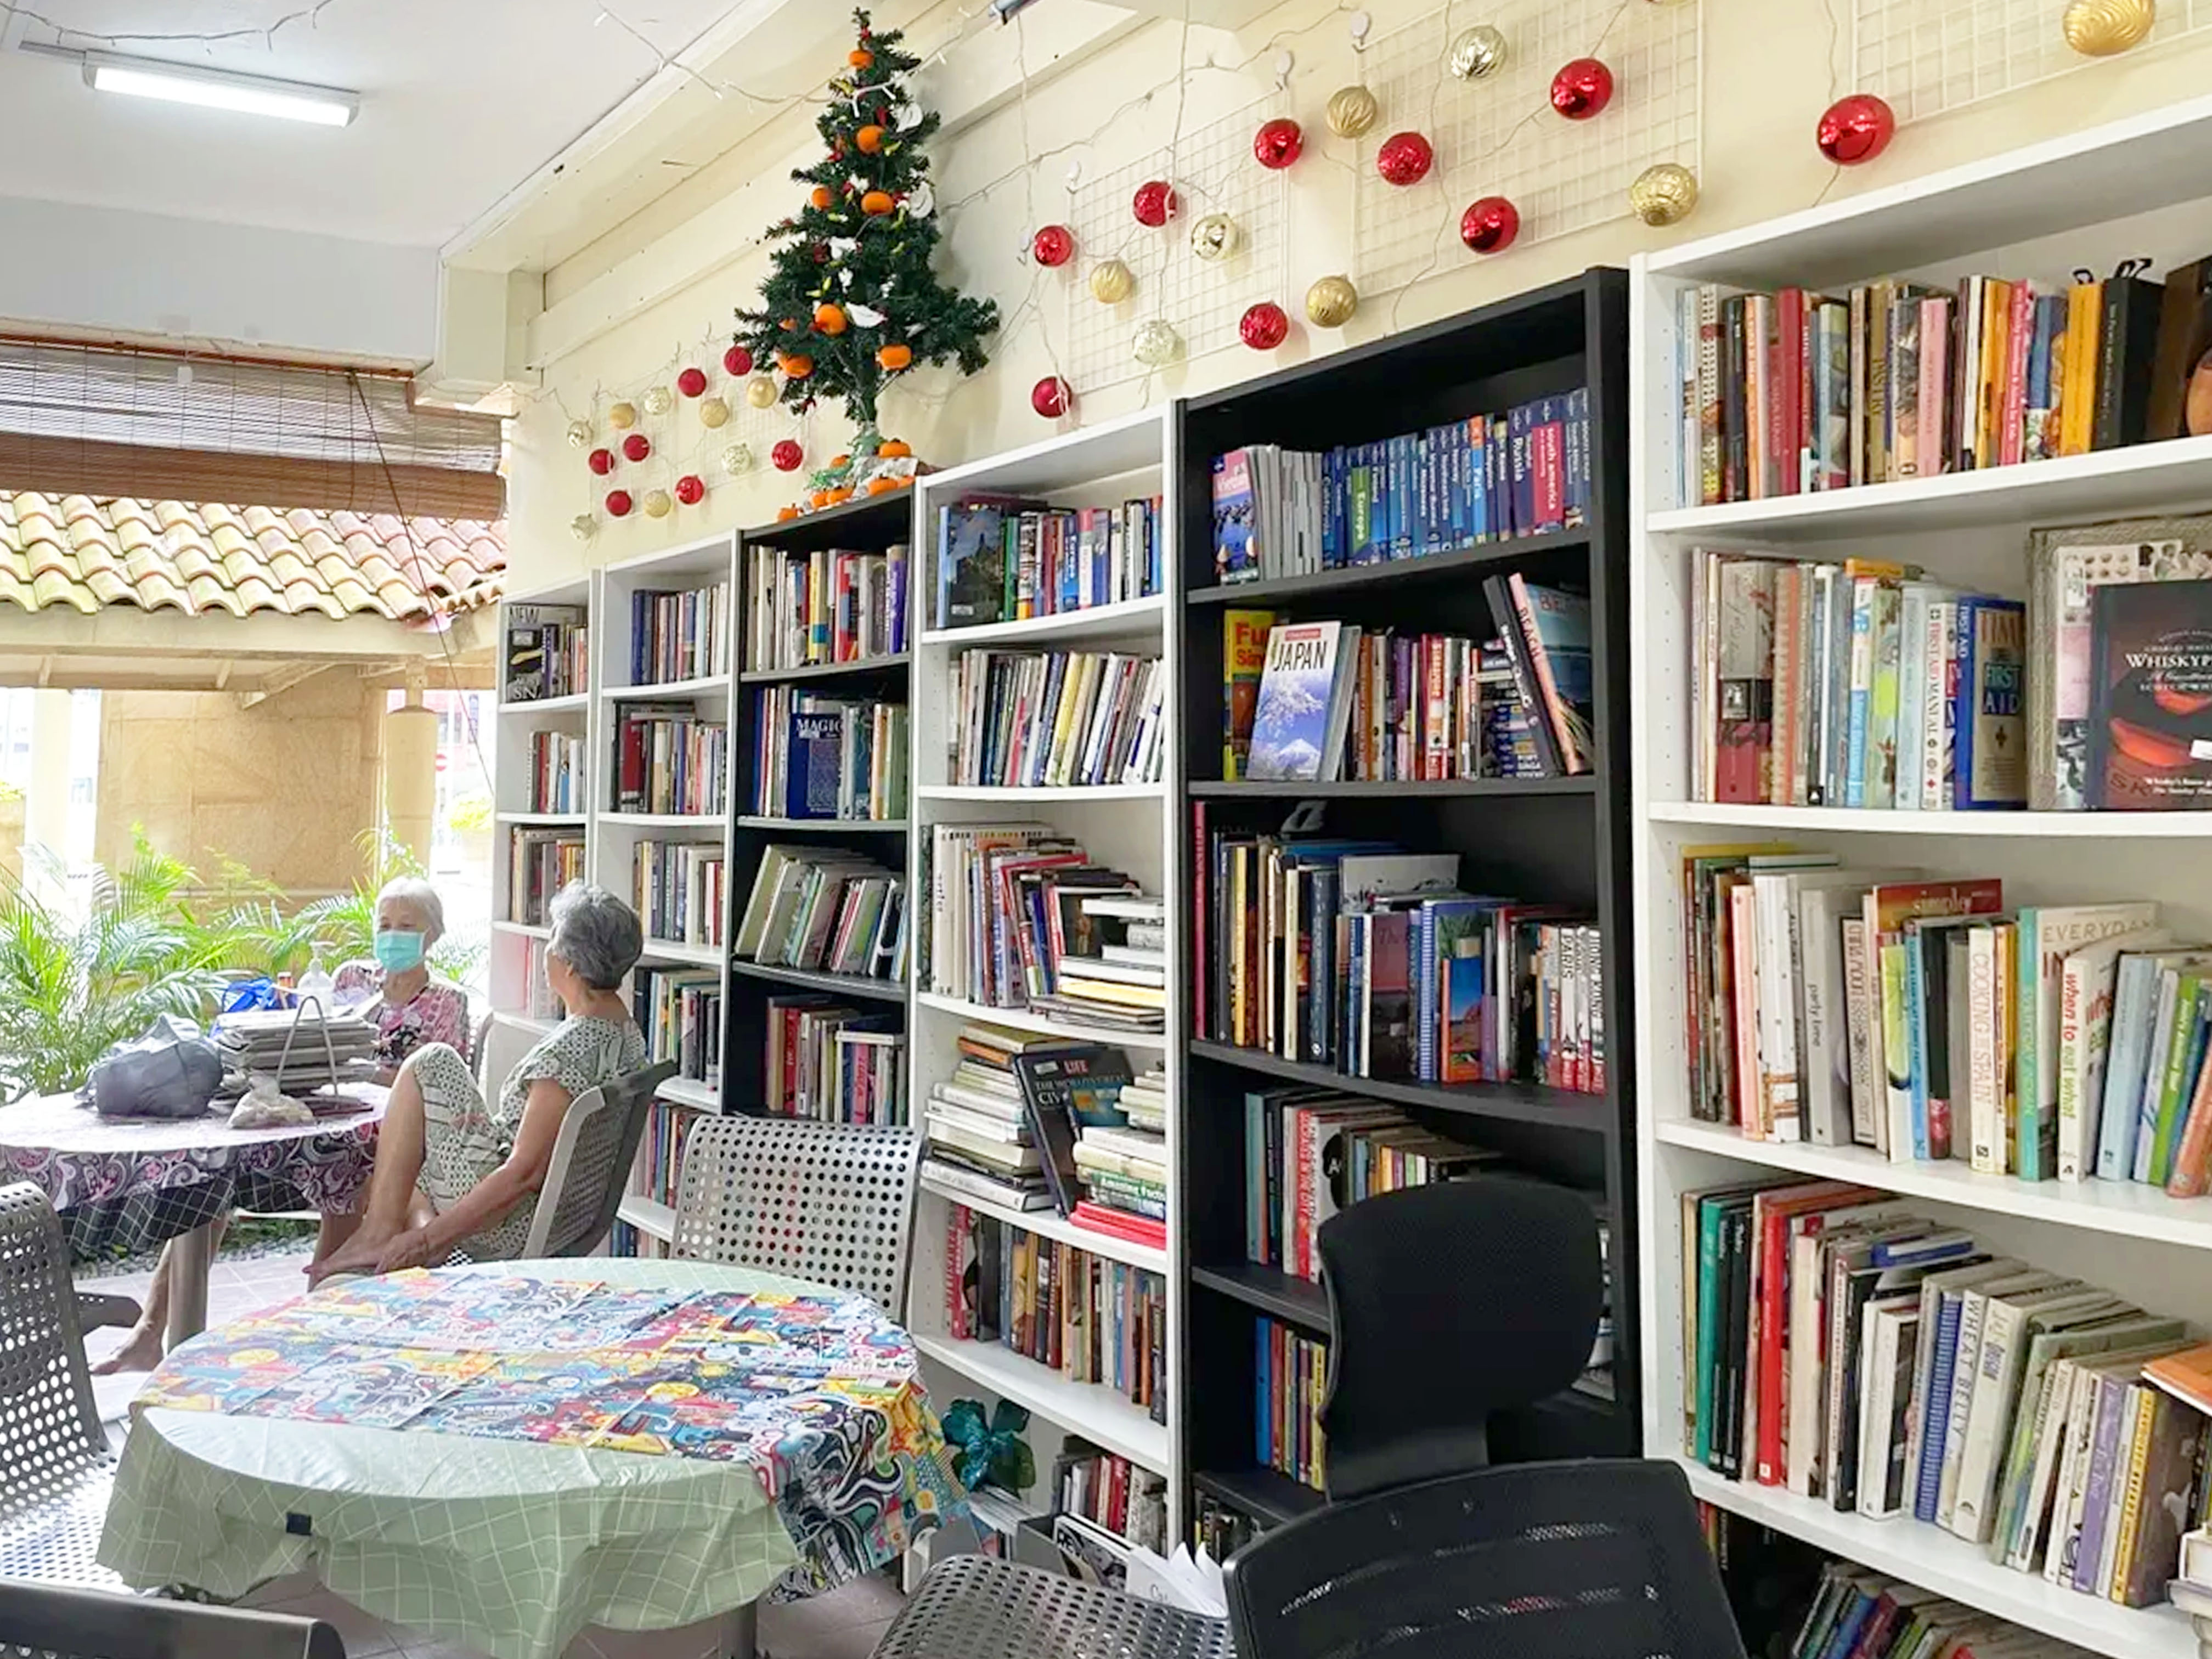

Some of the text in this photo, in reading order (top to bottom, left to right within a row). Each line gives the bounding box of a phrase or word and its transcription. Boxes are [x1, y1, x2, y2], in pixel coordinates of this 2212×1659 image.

[1513, 437, 1525, 482] Russia
[1356, 491, 1366, 540] Europe
[1273, 640, 1327, 672] JAPAN
[1959, 637, 1968, 658] AID
[1926, 623, 1941, 736] FIRST AID MANUAL
[1985, 664, 2021, 689] FIRST
[1984, 694, 2022, 714] AID
[1563, 935, 1573, 980] PARIS
[1808, 984, 1822, 1017] party
[1973, 953, 1993, 1104] COOKING SPAIN
[2062, 973, 2079, 1120] when to eat what
[1064, 1059, 1089, 1074] LIFE
[1951, 1300, 1980, 1440] WHEAT BELLY
